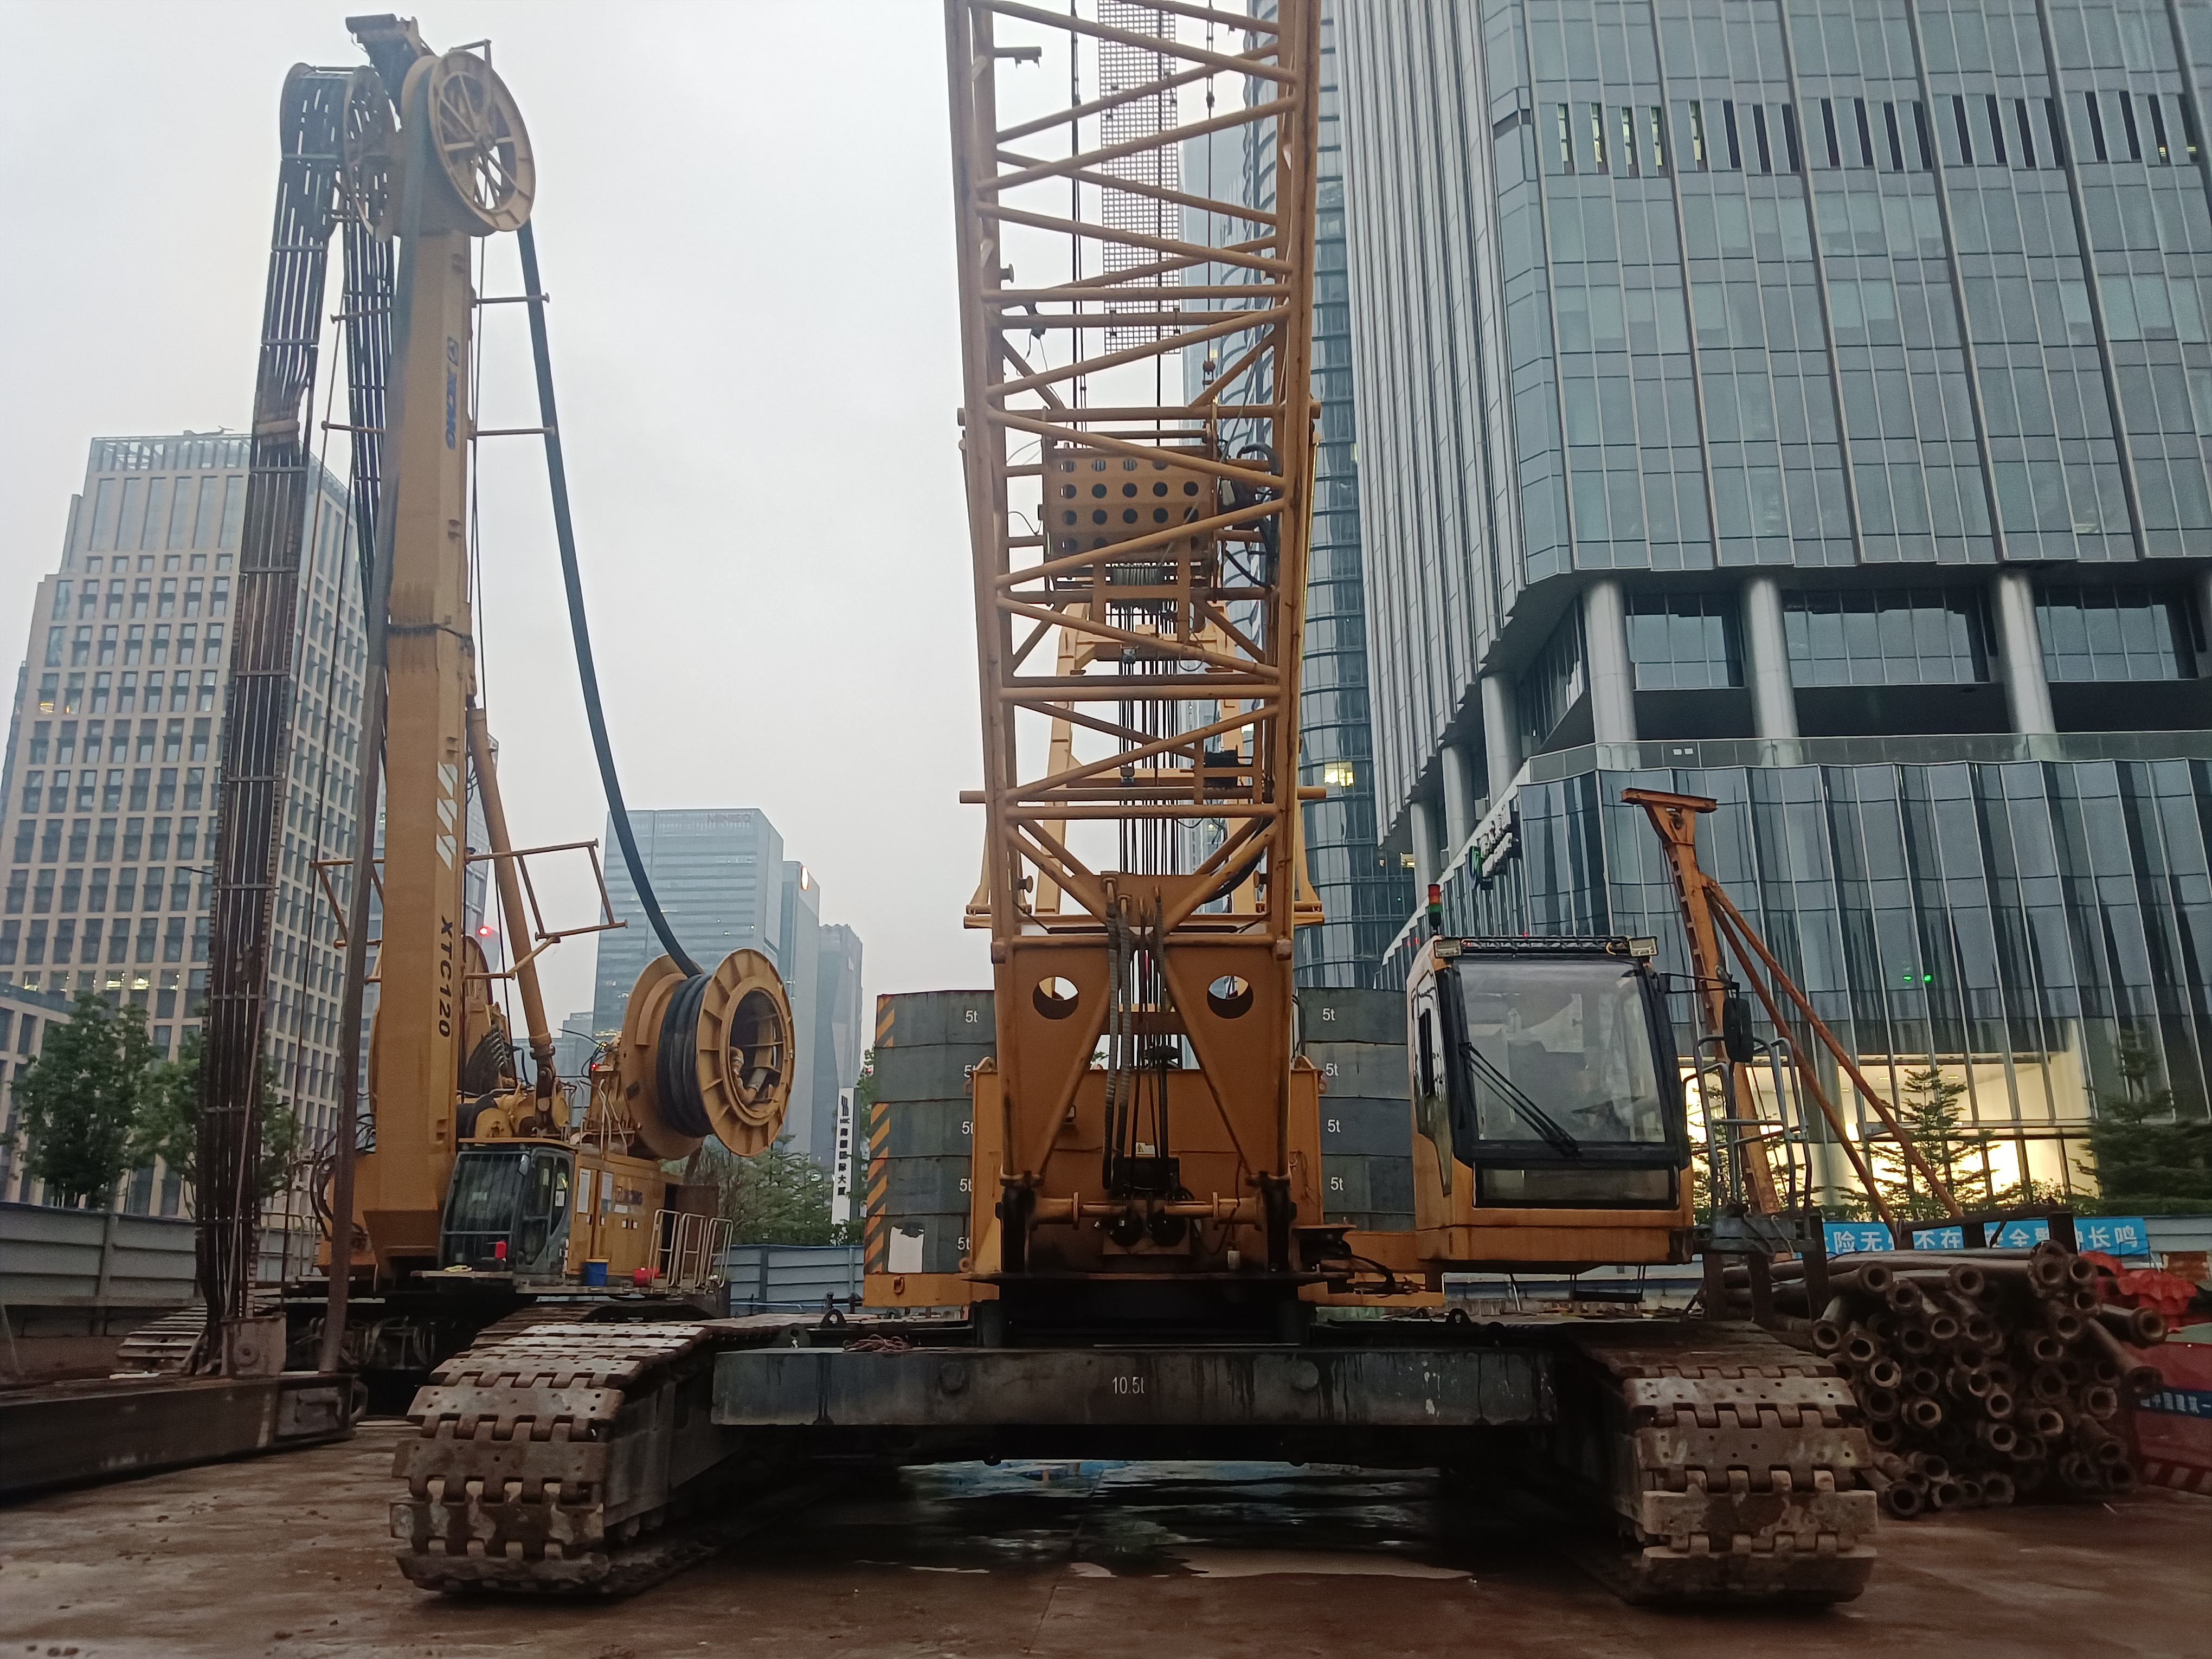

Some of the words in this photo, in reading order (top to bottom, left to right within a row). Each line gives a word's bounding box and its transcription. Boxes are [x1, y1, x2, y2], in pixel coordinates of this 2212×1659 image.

[439, 915, 453, 1038] XTC120
[966, 1010, 978, 1023] 5t
[1323, 1008, 1335, 1021] 5t
[1326, 1062, 1339, 1076] 5t
[962, 1121, 974, 1134] 5t
[1328, 1119, 1341, 1133] 5t
[959, 1178, 972, 1192] 5t
[1330, 1176, 1343, 1191] 5t
[957, 1237, 970, 1250] 5t
[1825, 1230, 1962, 1253] 险无不在
